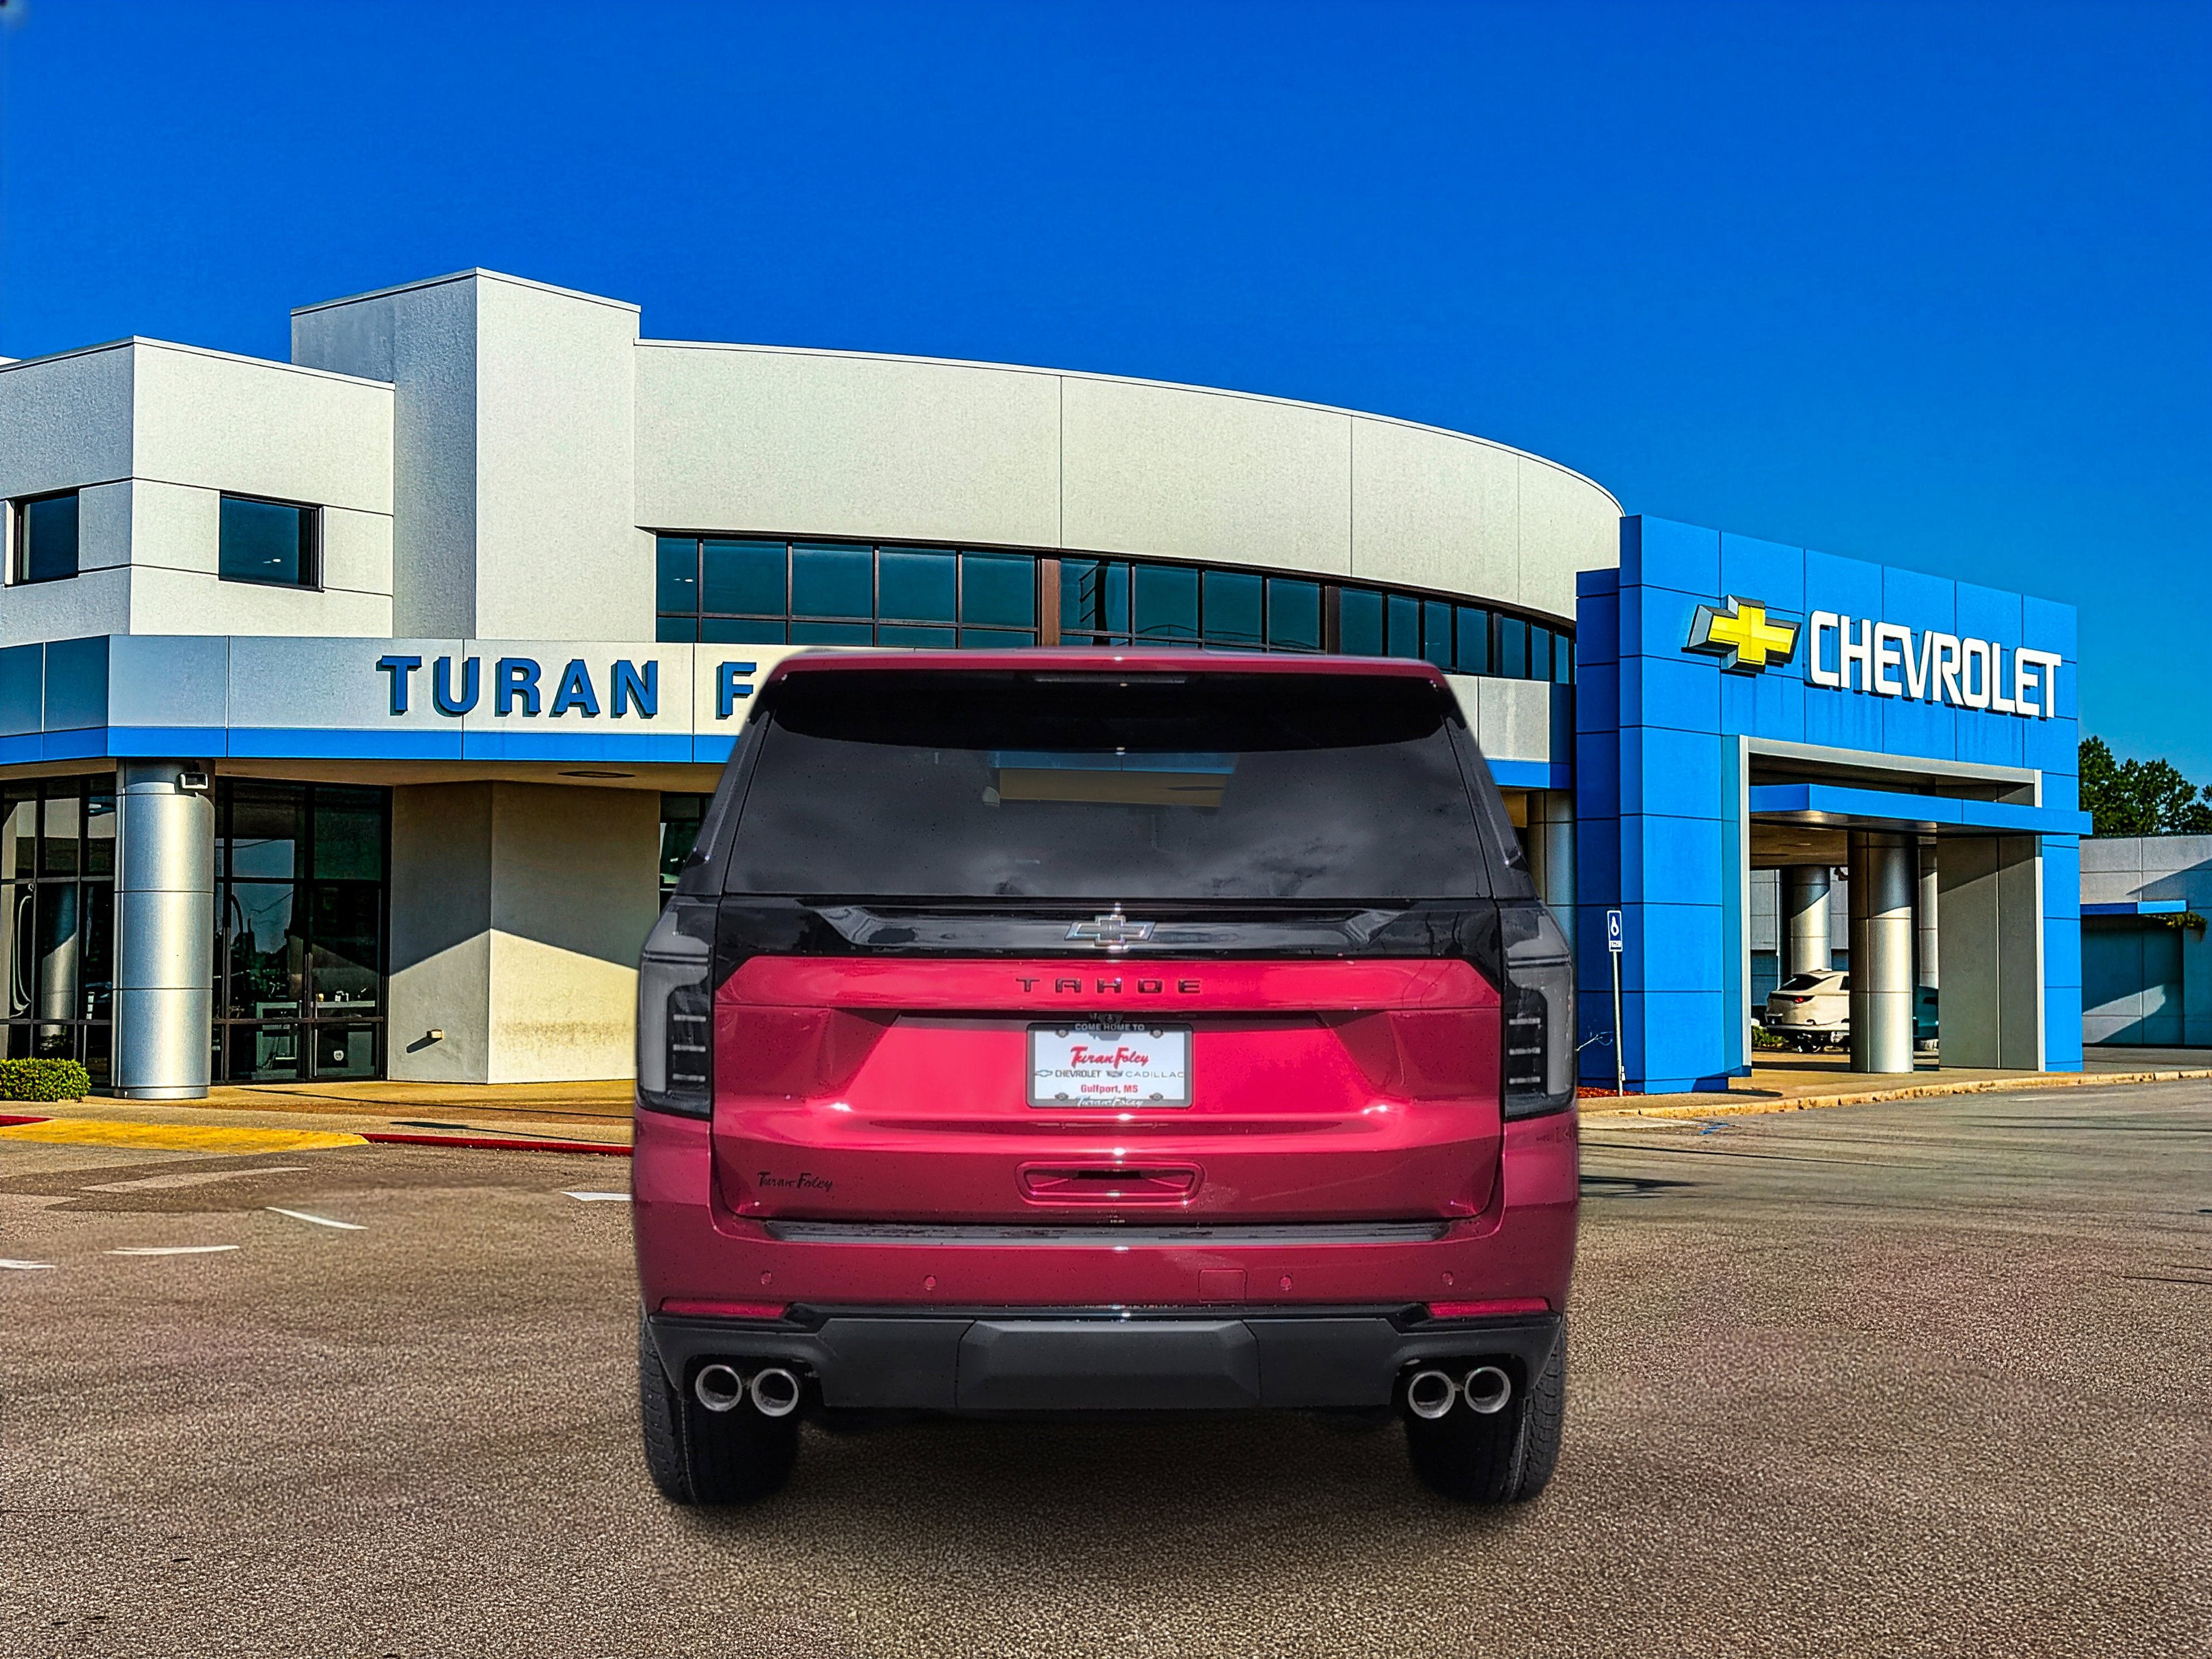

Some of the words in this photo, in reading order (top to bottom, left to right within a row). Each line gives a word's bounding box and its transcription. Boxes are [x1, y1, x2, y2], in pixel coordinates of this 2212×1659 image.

[1809, 610, 2062, 718] CHEVROLET
[376, 654, 658, 719] TURAN
[716, 661, 757, 720] F
[1015, 978, 1200, 993] TAHOE
[1081, 1084, 1121, 1094] Gulfport,
[1123, 1084, 1139, 1092] MS
